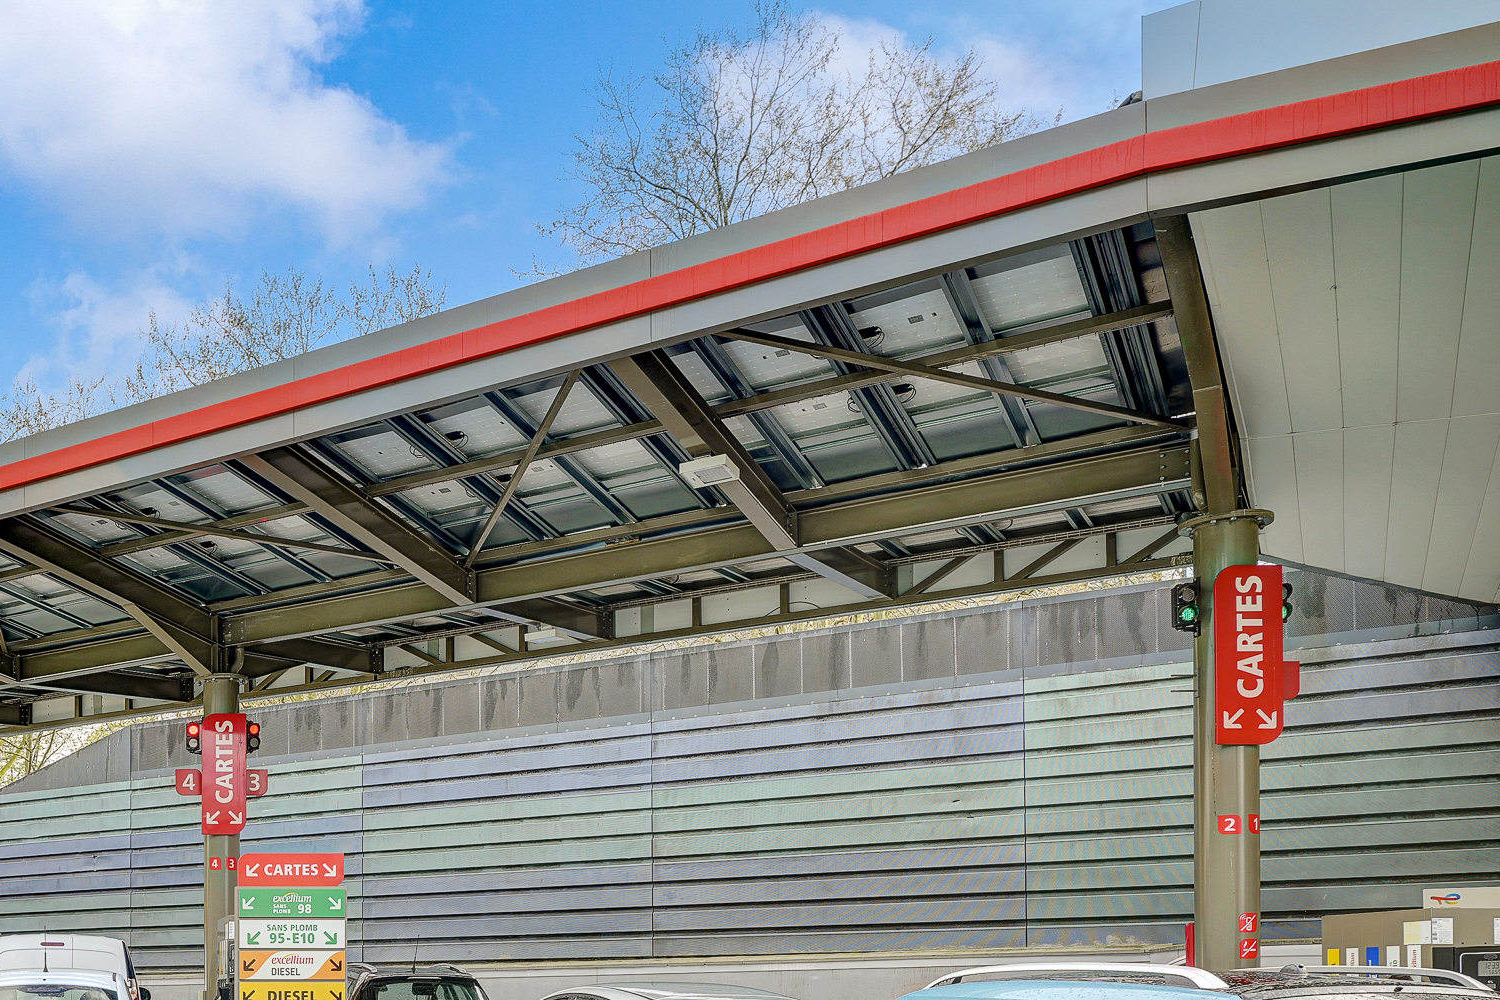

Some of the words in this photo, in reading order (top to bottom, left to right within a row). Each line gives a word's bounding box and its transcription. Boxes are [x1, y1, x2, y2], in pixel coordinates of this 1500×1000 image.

[1235, 575, 1264, 698] CARTES
[215, 720, 234, 804] CARTES
[182, 773, 196, 791] 4
[249, 773, 261, 792] 3
[1224, 818, 1236, 832] 2
[1253, 817, 1258, 831] 1
[211, 859, 218, 868] 4
[228, 859, 235, 869] 3
[263, 863, 319, 876] CARTES
[272, 892, 312, 903] excellium
[297, 904, 312, 914] 98
[269, 933, 315, 944] 95-E10
[271, 953, 315, 965] excellium
[271, 967, 301, 976] DIESEL
